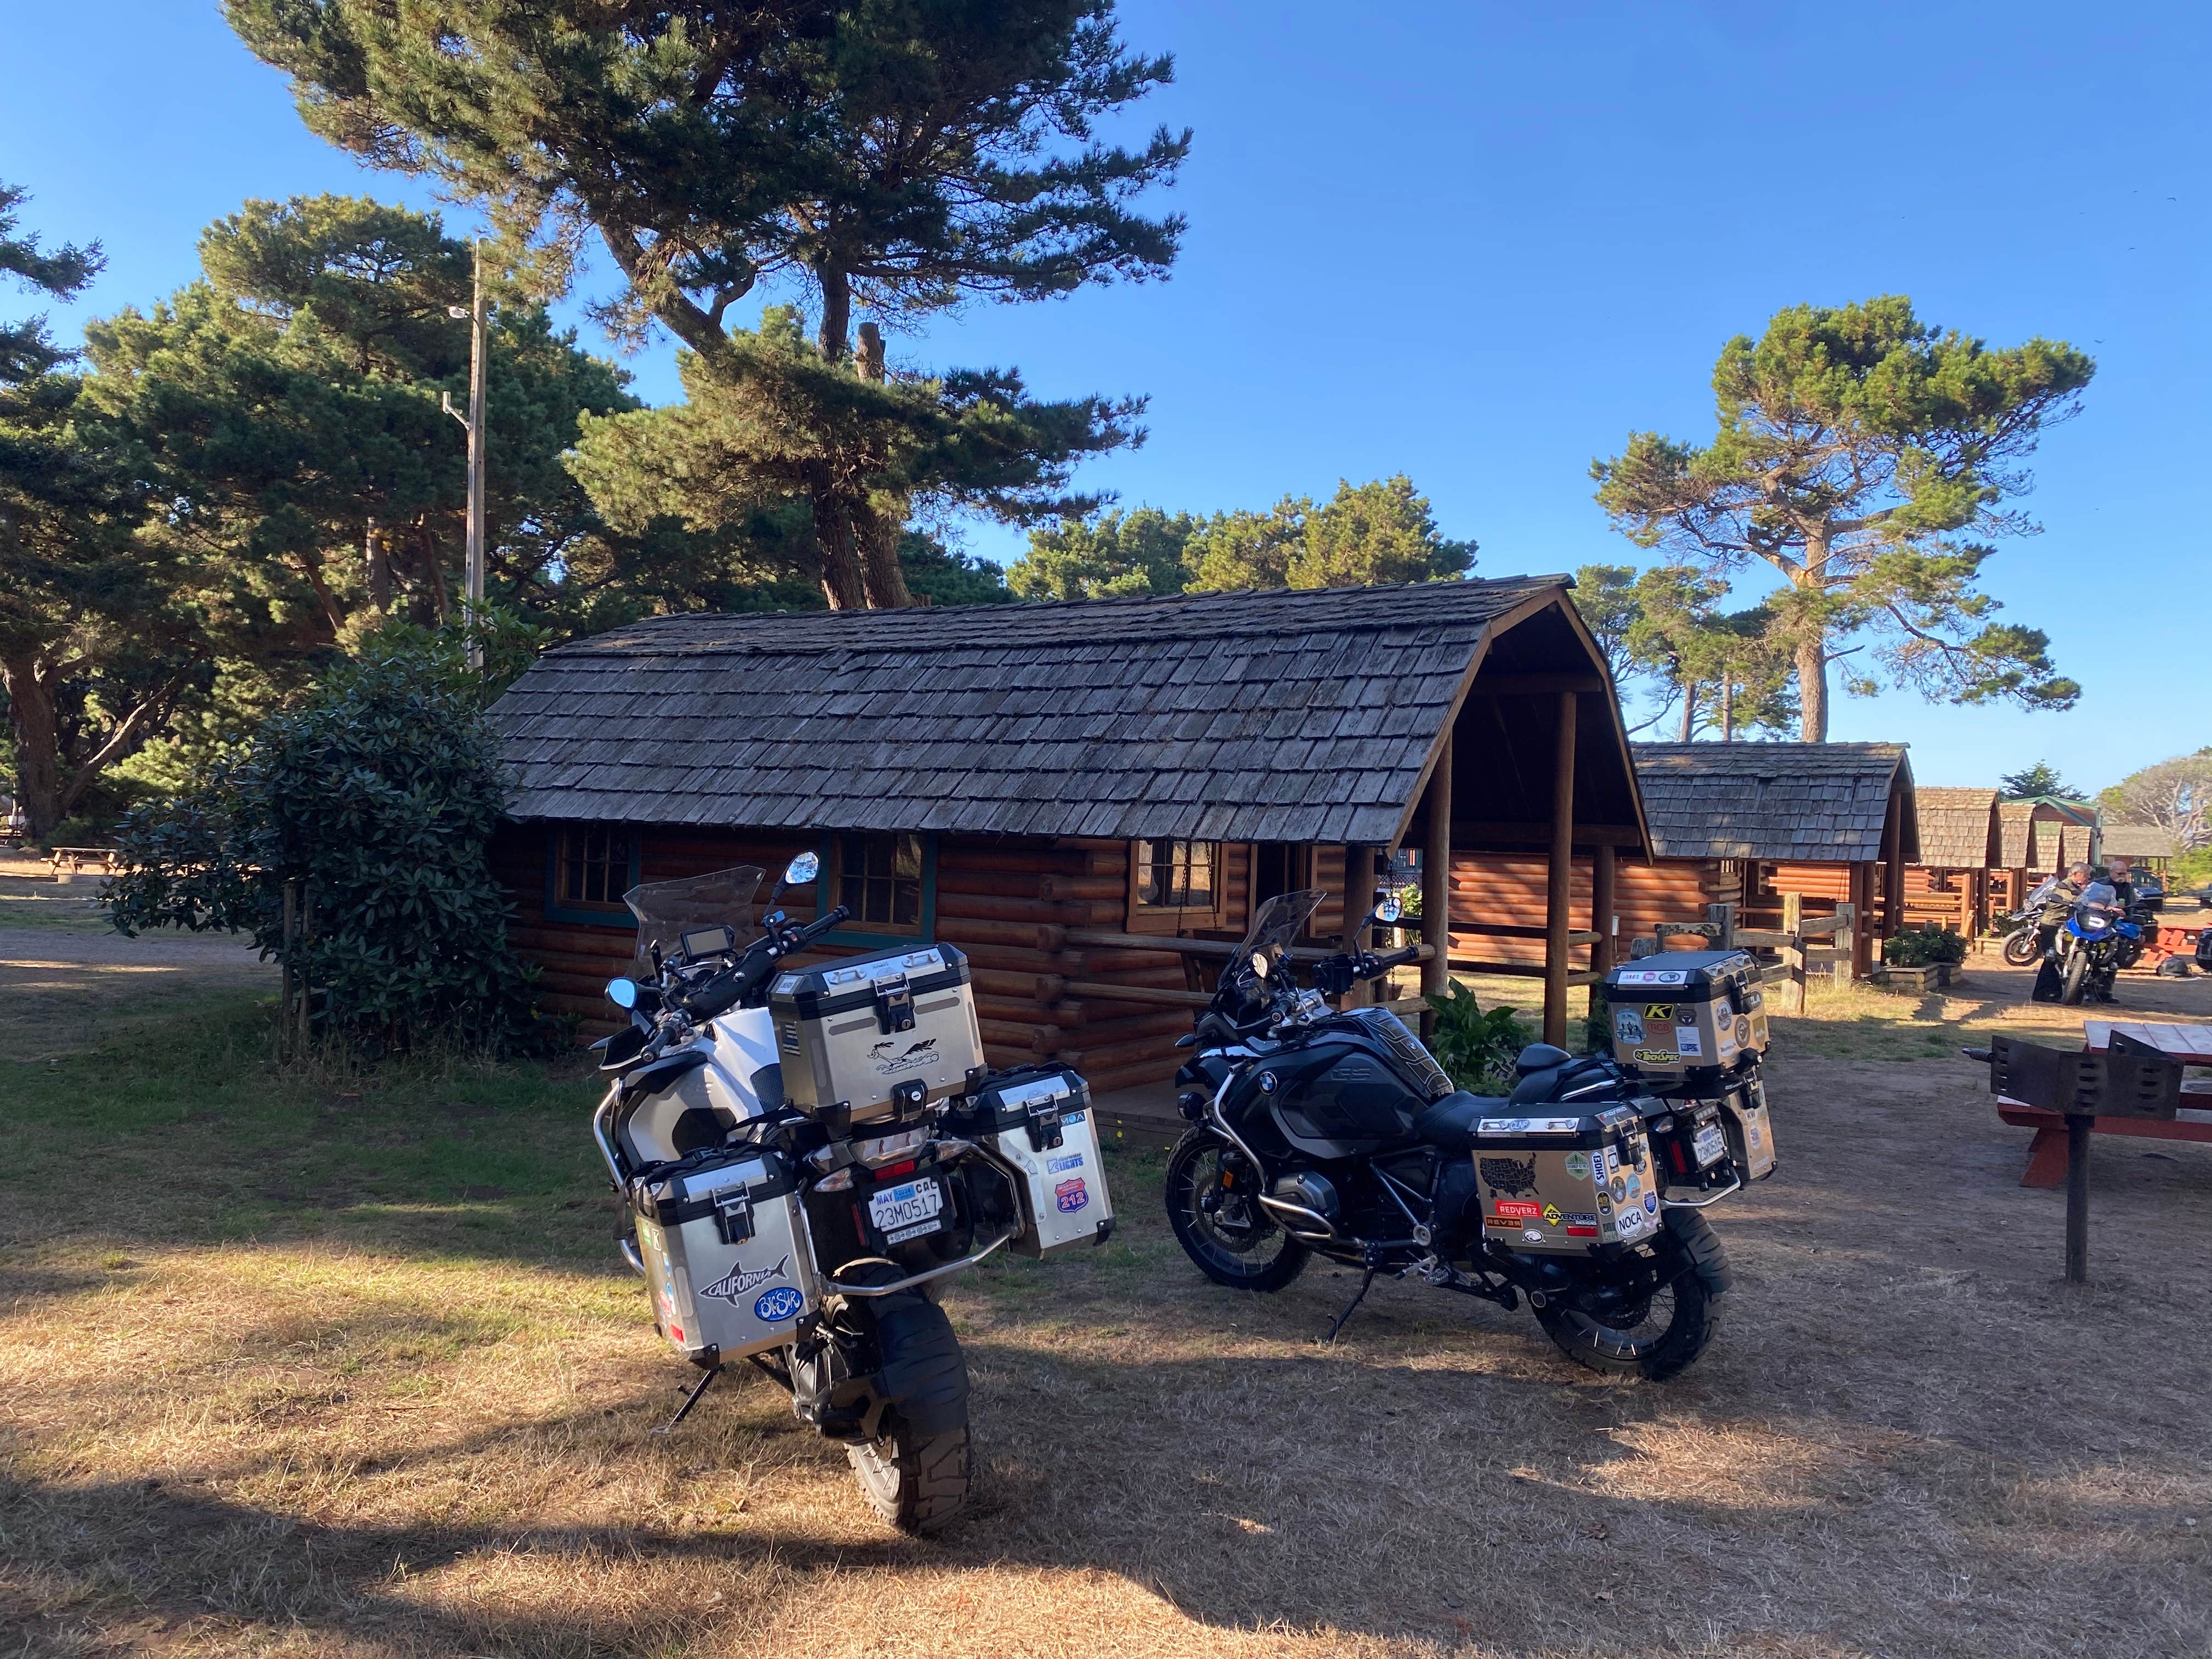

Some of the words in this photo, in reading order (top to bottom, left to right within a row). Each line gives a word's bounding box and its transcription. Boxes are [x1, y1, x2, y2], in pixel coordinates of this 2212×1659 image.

[1645, 1005, 1672, 1018] K
[1059, 1156, 1084, 1171] LIGHTS
[1593, 1155, 1605, 1181] SHOEI
[876, 1192, 893, 1205] MAY
[916, 1181, 938, 1193] CAL
[1060, 1191, 1085, 1209] 212
[876, 1194, 937, 1228] 23M0517
[1499, 1206, 1538, 1216] REDVERZ
[1618, 1211, 1643, 1232] NOCA
[708, 1271, 771, 1296] CALIFORNIA
